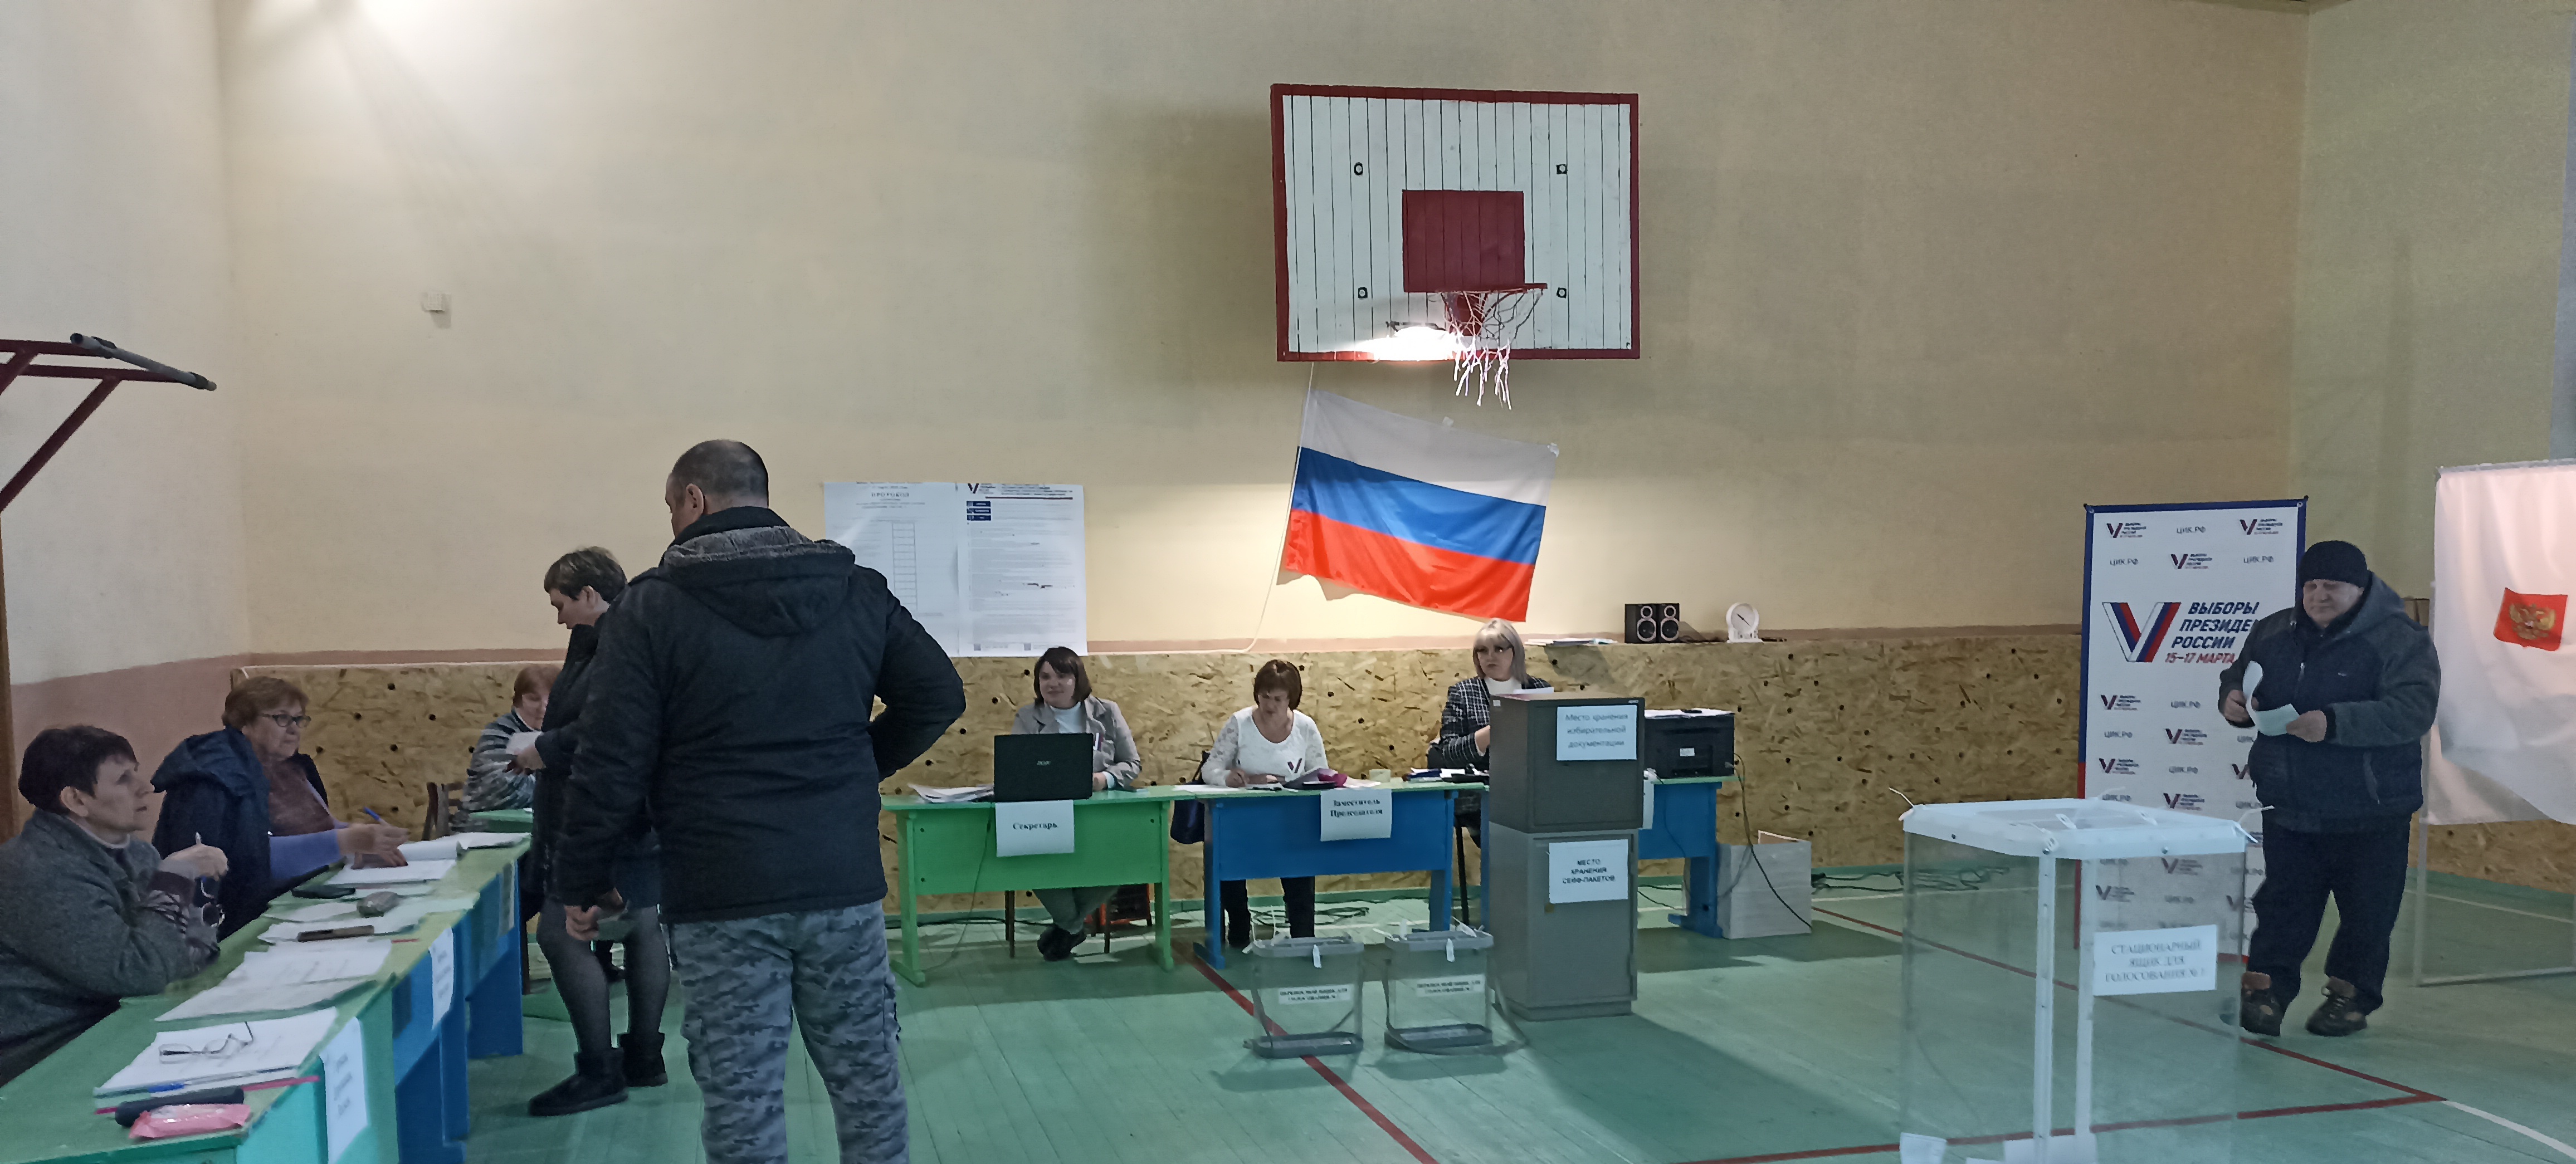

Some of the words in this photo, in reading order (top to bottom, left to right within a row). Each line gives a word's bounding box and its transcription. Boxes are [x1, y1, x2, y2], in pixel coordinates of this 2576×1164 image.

[2188, 601, 2260, 614] ВЫБОРЫ
[2179, 619, 2257, 633] ПРЕЗИДЕ
[2172, 636, 2236, 649] РОССИИ
[2196, 653, 2236, 664] МАРТА
[1592, 714, 1628, 722] хранения
[1567, 725, 1627, 735] избирательной
[1568, 740, 1625, 749] документации
[1330, 809, 1383, 818] Председателя
[1013, 822, 1058, 830] Секретарь
[2111, 939, 2200, 954] СТАЦИОНАРНЫЙ
[2129, 957, 2160, 967] ЯЩИК
[2105, 969, 2185, 982] ГОЛОСОВАНИЯ
